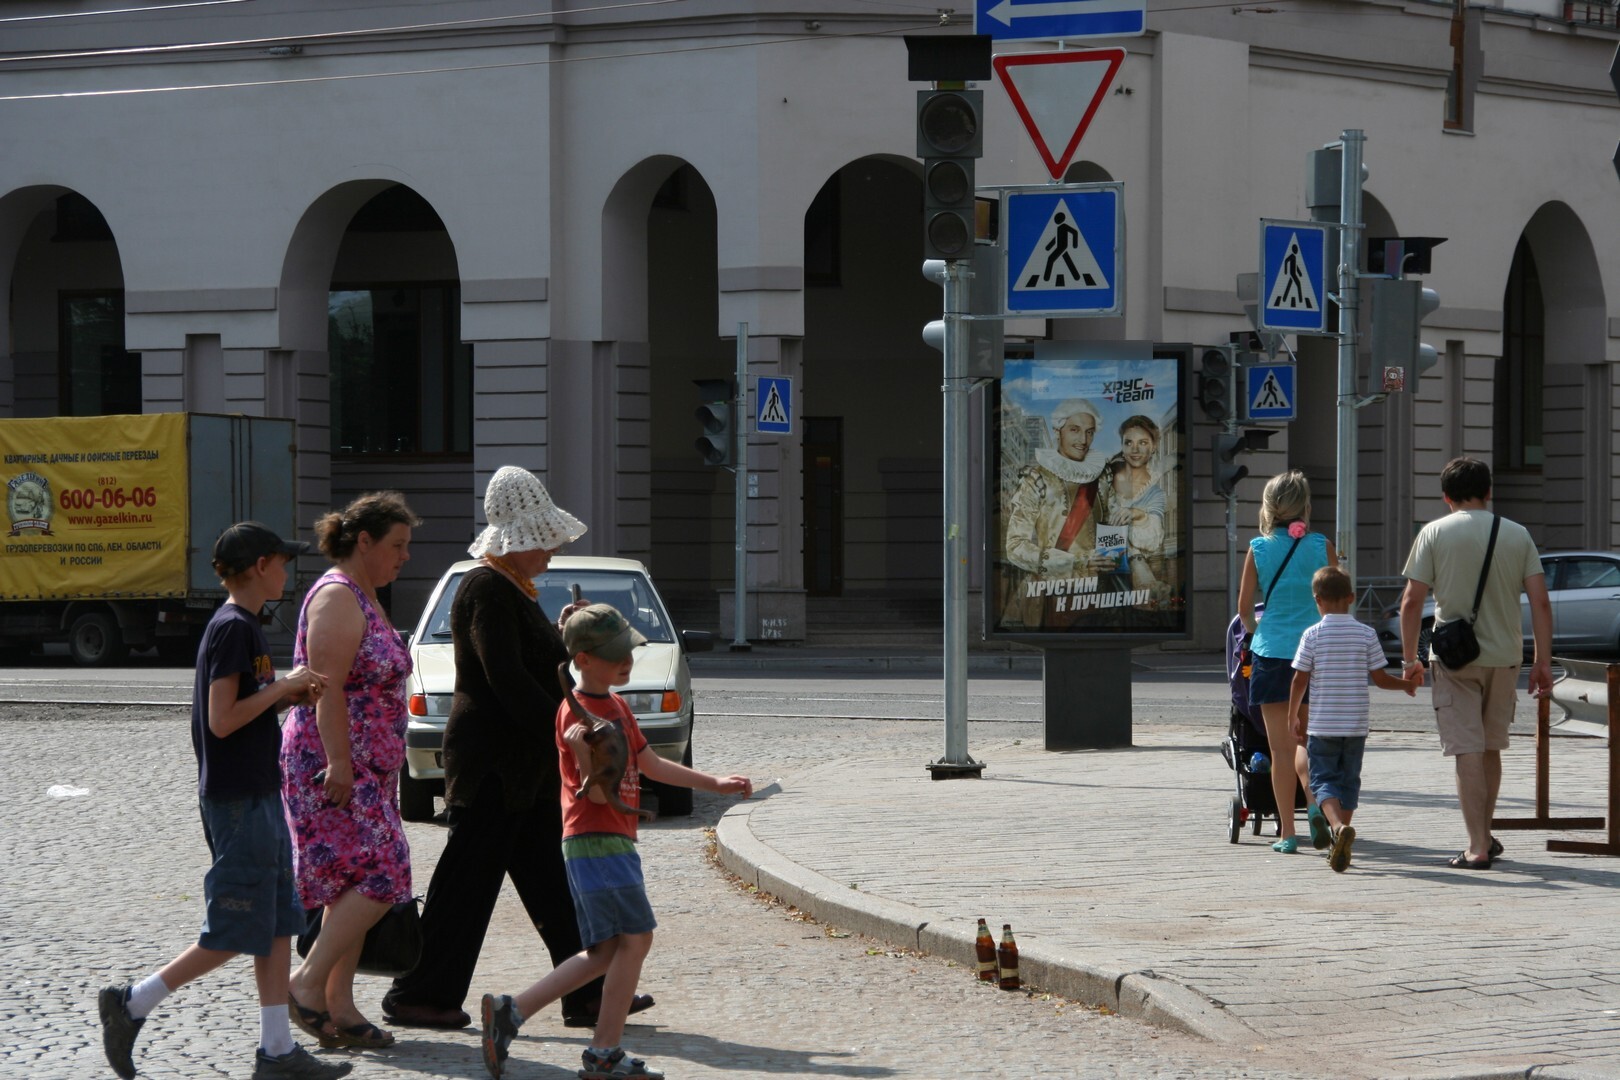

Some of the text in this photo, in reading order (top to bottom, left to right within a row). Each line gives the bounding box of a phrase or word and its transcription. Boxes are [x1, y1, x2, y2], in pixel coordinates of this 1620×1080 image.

[1116, 389, 1154, 404] team
[50, 453, 79, 465] ДАЧНЫЕ
[81, 453, 86, 462] И
[87, 451, 121, 462] ОФИСНЫЕ
[122, 449, 159, 462] ПЕРЕЕЗДЫ
[98, 477, 117, 487] (812)
[60, 487, 157, 510] 600-06-06
[68, 513, 153, 527] www.gazelkin.ru
[5, 543, 74, 553] ГРУЗОПЕРЕВОЗКИ
[75, 543, 86, 552] ПО
[127, 541, 161, 551] ОБЛАСТИ
[60, 556, 102, 566] И РОССИИ
[1026, 576, 1098, 598] ХРУСТИМ
[1056, 589, 1150, 612] К ЛУЧШЕМУ!
